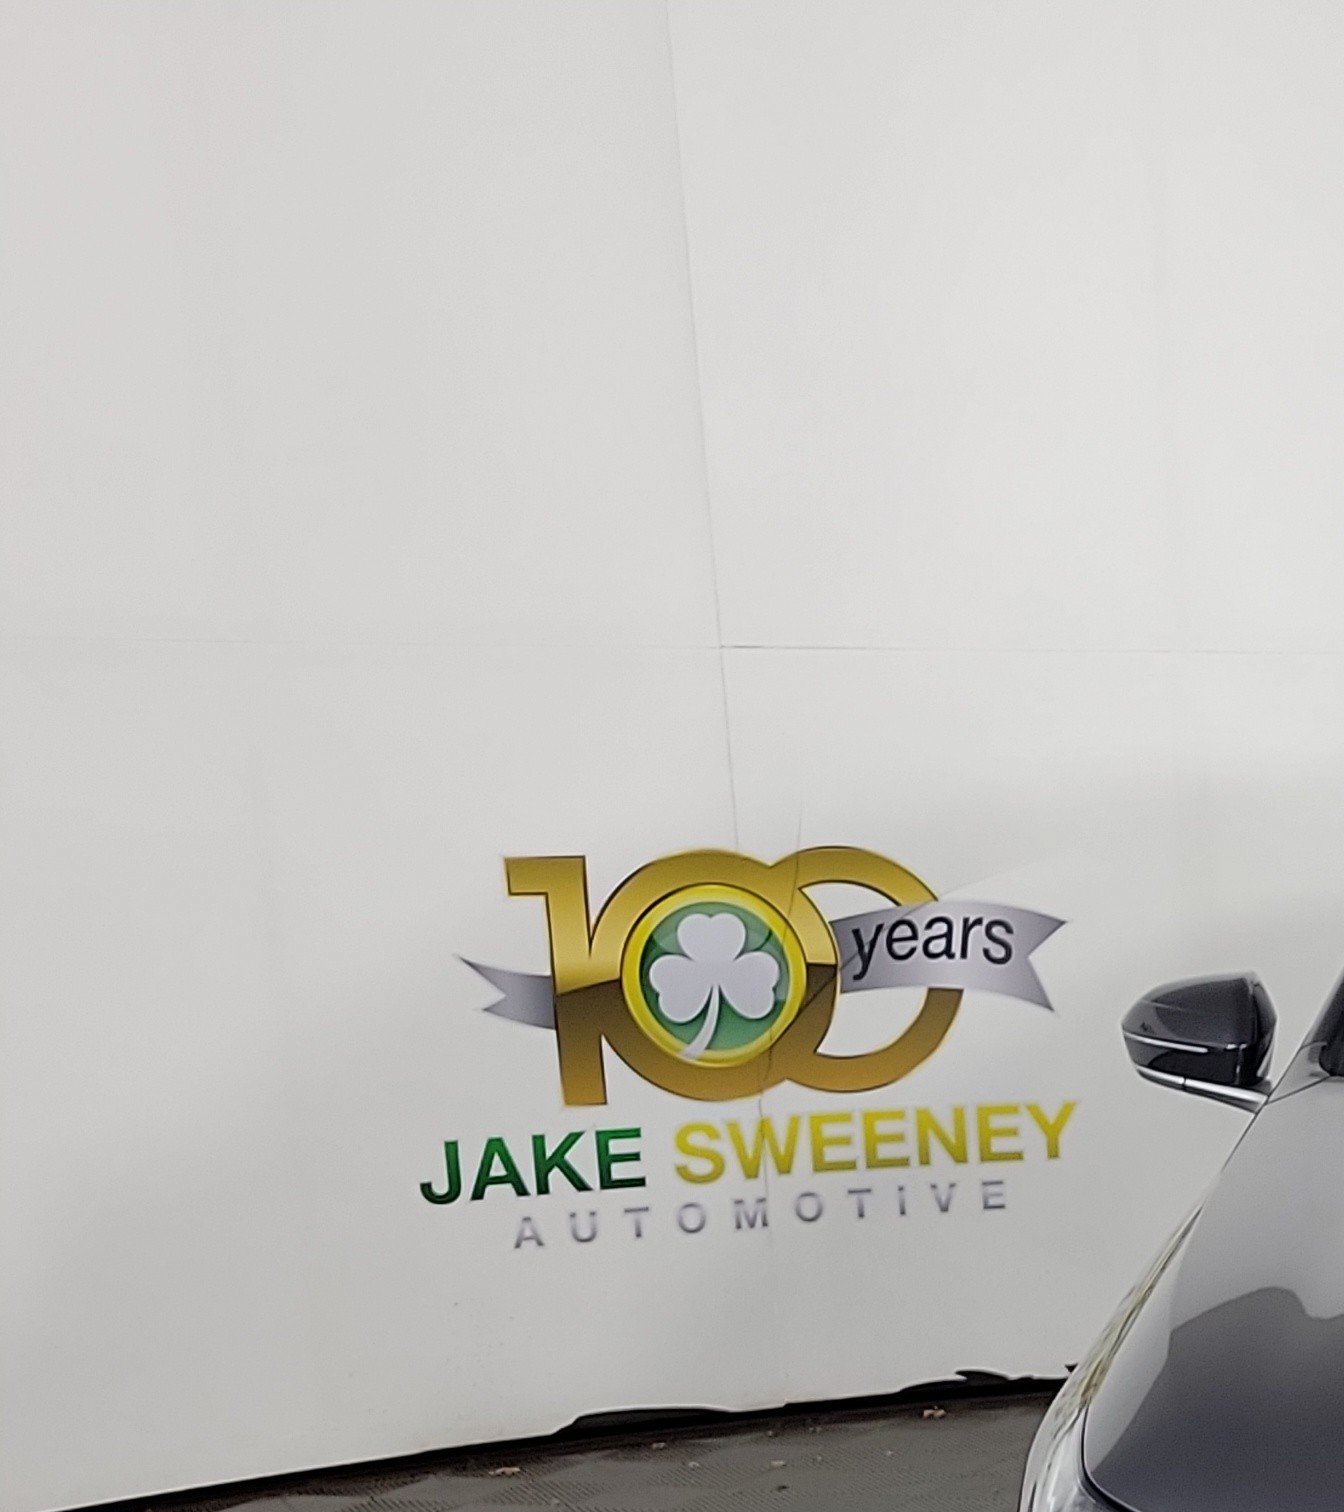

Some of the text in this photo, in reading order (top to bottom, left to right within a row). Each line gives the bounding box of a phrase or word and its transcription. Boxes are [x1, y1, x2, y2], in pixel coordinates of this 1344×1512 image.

[503, 845, 1014, 1107] 100 years
[419, 1101, 1078, 1206] JAKE SWEENEY
